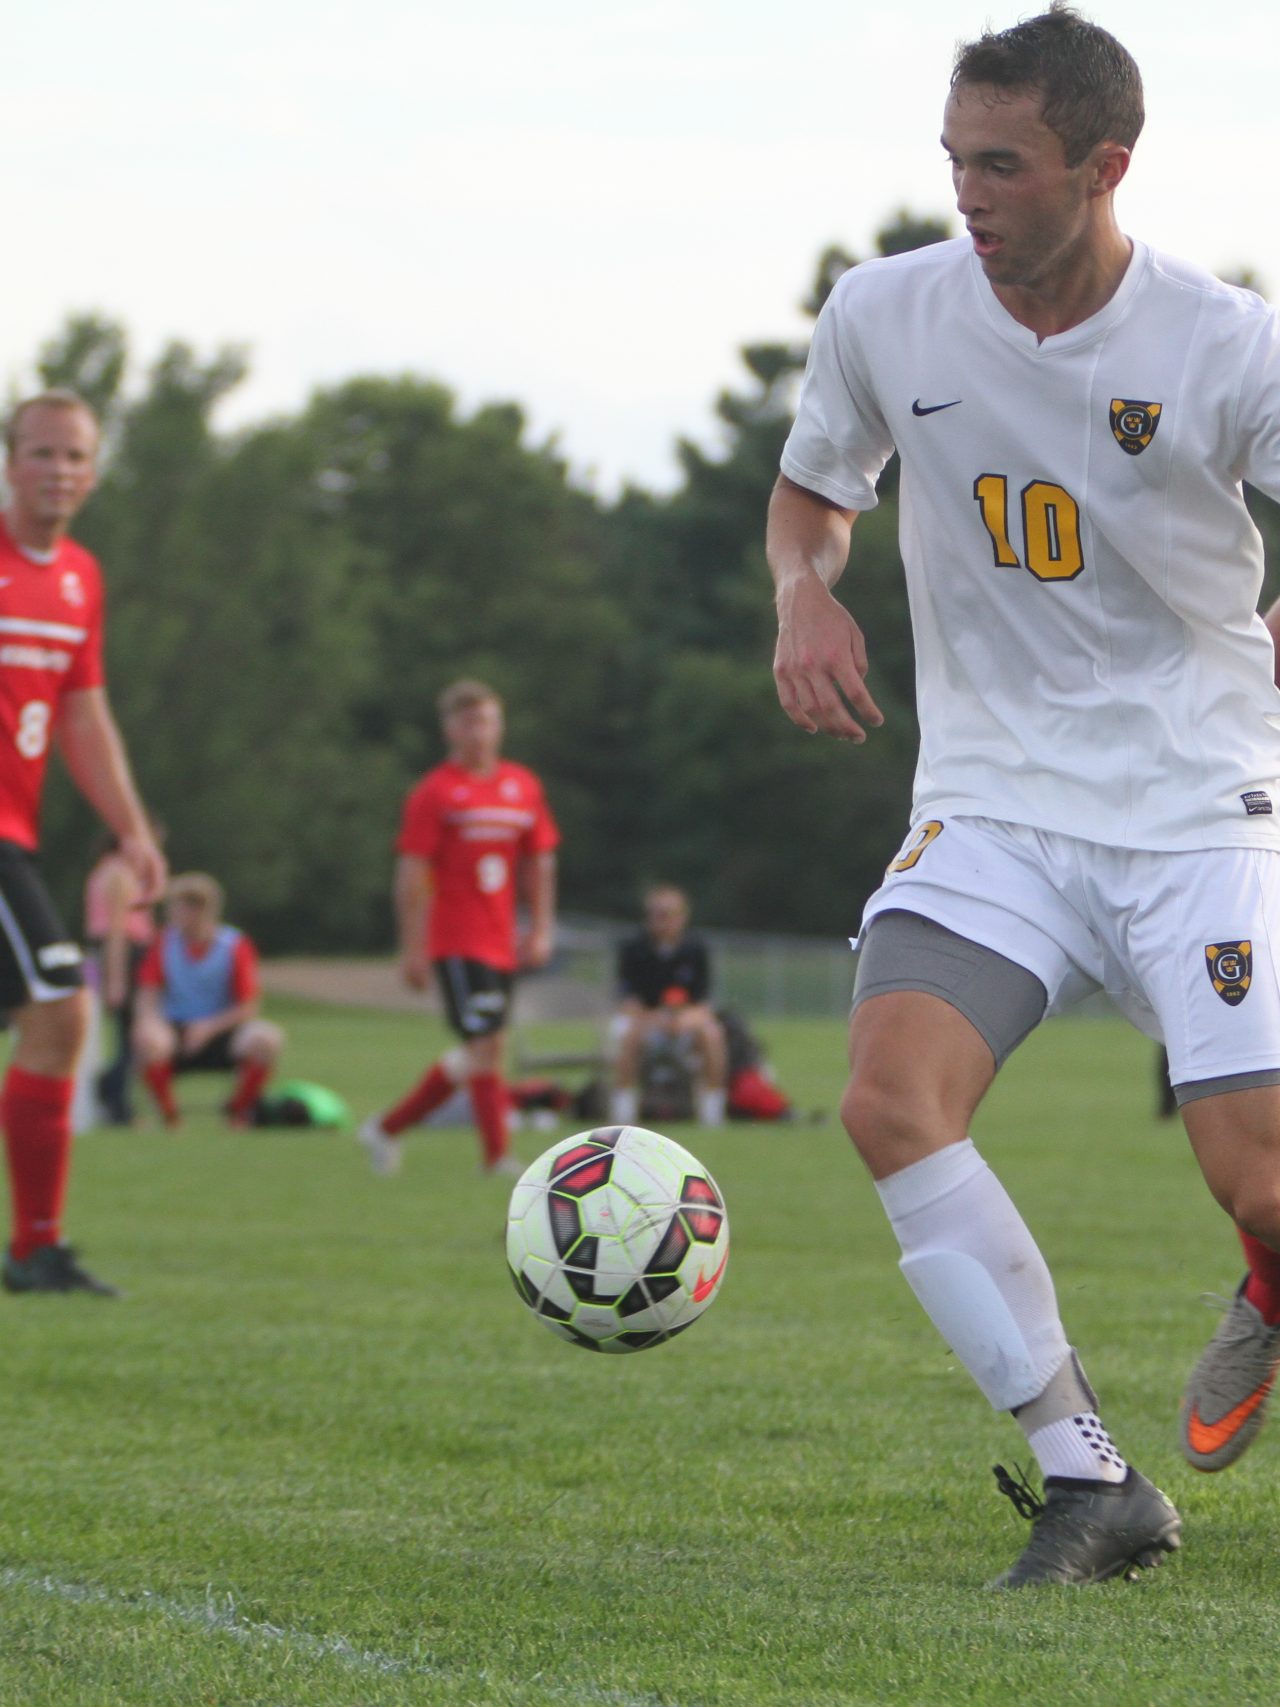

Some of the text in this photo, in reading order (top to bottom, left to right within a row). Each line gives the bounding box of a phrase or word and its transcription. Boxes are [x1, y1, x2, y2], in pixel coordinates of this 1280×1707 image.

[1120, 411, 1144, 435] G
[973, 473, 1084, 582] 10
[16, 701, 51, 760] 8
[1217, 953, 1240, 980] G
